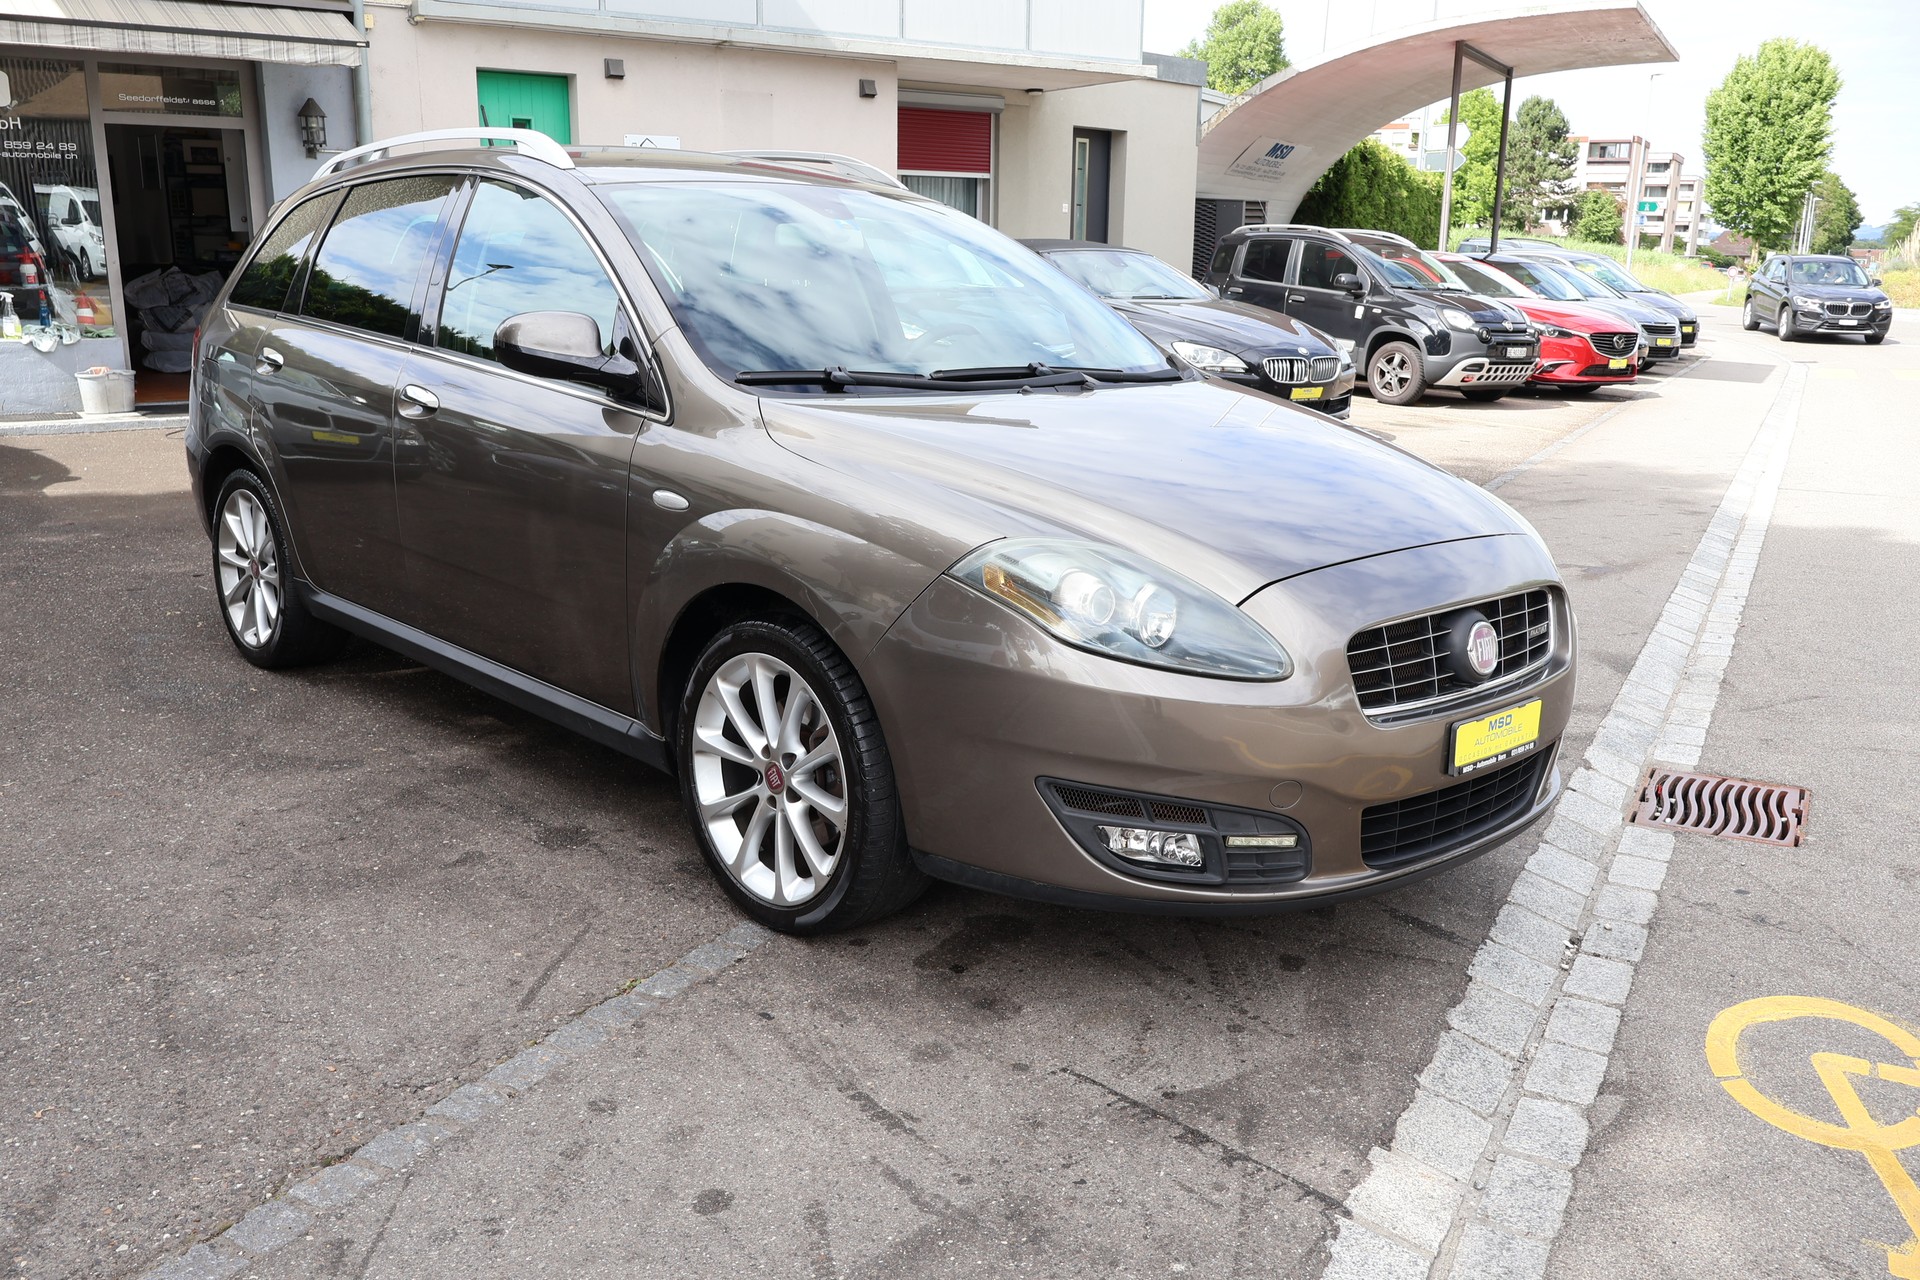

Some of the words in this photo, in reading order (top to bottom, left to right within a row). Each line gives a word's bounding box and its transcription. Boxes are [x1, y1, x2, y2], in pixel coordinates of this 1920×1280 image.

[3, 140, 31, 150] 859
[36, 142, 54, 150] 24
[58, 142, 77, 151] 89
[1265, 143, 1295, 159] MSD
[1488, 714, 1513, 732] MSD
[1474, 723, 1523, 747] AUTOMOBILE
[767, 768, 781, 788] FIAT
